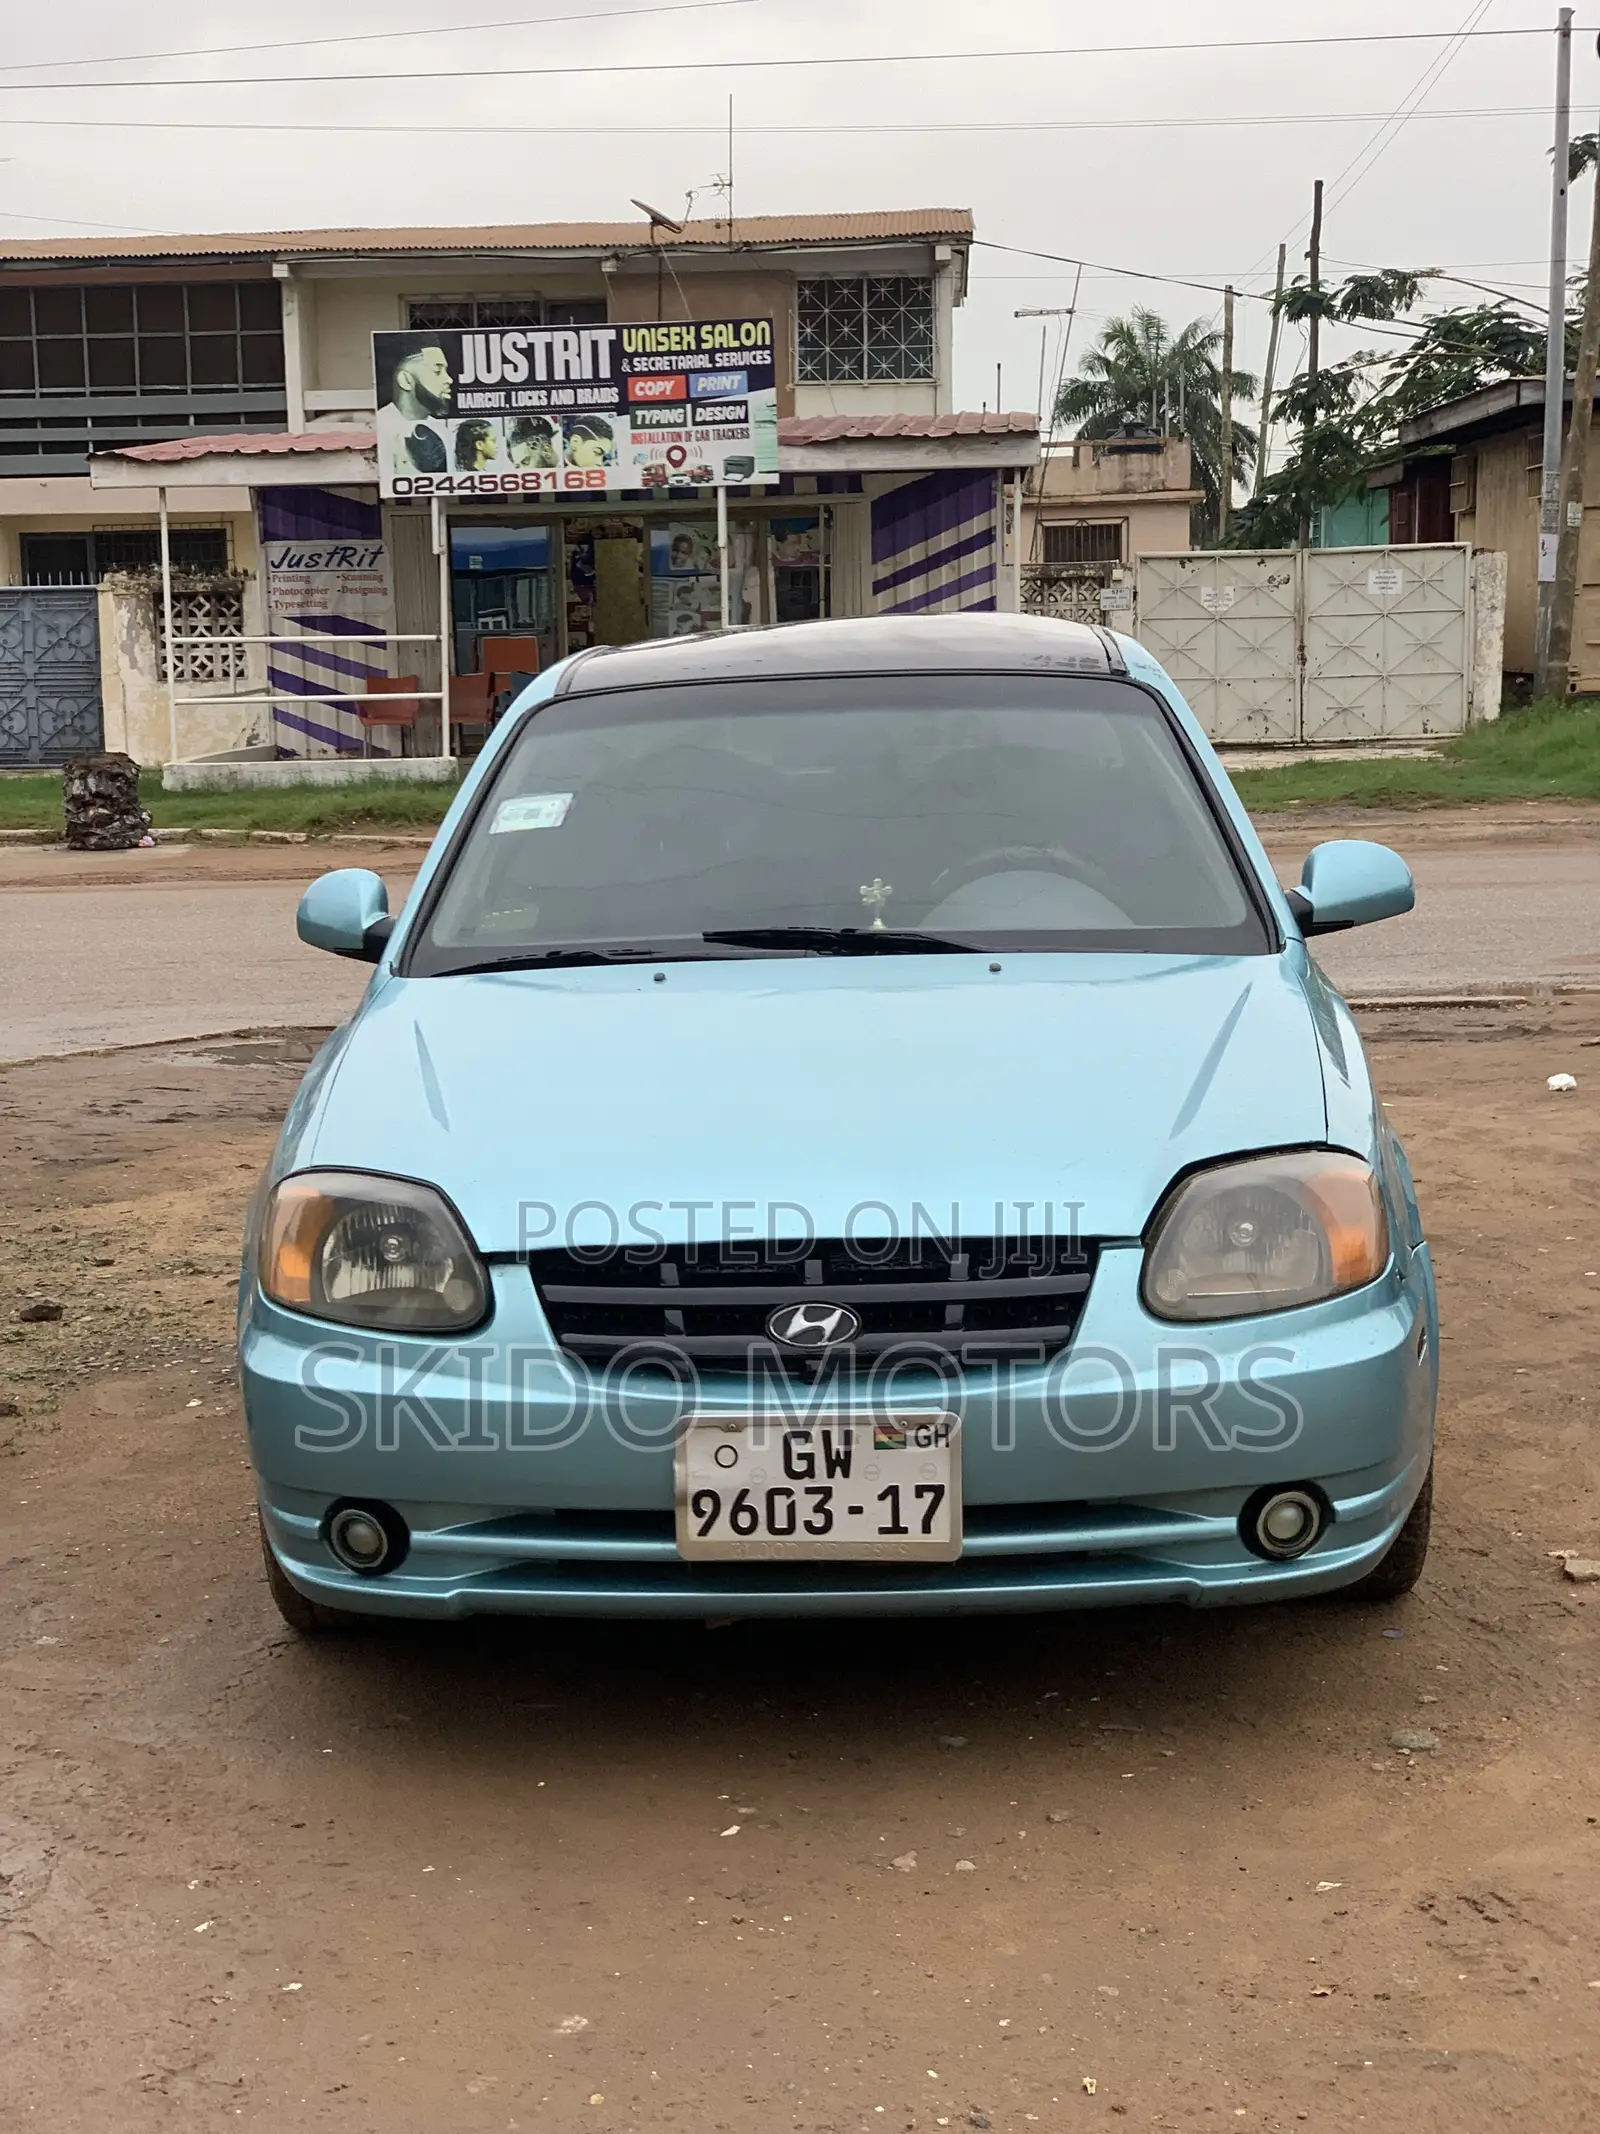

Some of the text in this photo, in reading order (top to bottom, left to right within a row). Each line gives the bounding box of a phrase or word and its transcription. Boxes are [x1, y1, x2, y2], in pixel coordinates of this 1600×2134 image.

[622, 320, 771, 353] UNISEX SALON
[458, 329, 617, 384] JUSTRIT
[621, 350, 772, 372] & SECRETARIAL SERVICES
[634, 380, 676, 397] COPY
[697, 374, 742, 392] PRINT
[457, 386, 619, 409] HAIRCUT, LOCKS AND BRAIDS
[635, 408, 685, 425] TYPING
[695, 405, 747, 422] DESIGN
[631, 427, 750, 445] INSTALLATION OF CAR TRACKERS
[392, 469, 606, 495] 0244568168
[271, 545, 384, 569] JustRit
[272, 574, 311, 584] Printing
[341, 573, 384, 583] Scanning
[272, 587, 330, 596] Photocopier
[341, 586, 388, 596] Designing
[274, 600, 329, 610] Typesetting
[914, 1423, 950, 1448] GH
[782, 1429, 854, 1481] GW
[692, 1483, 946, 1537] 9603-17
